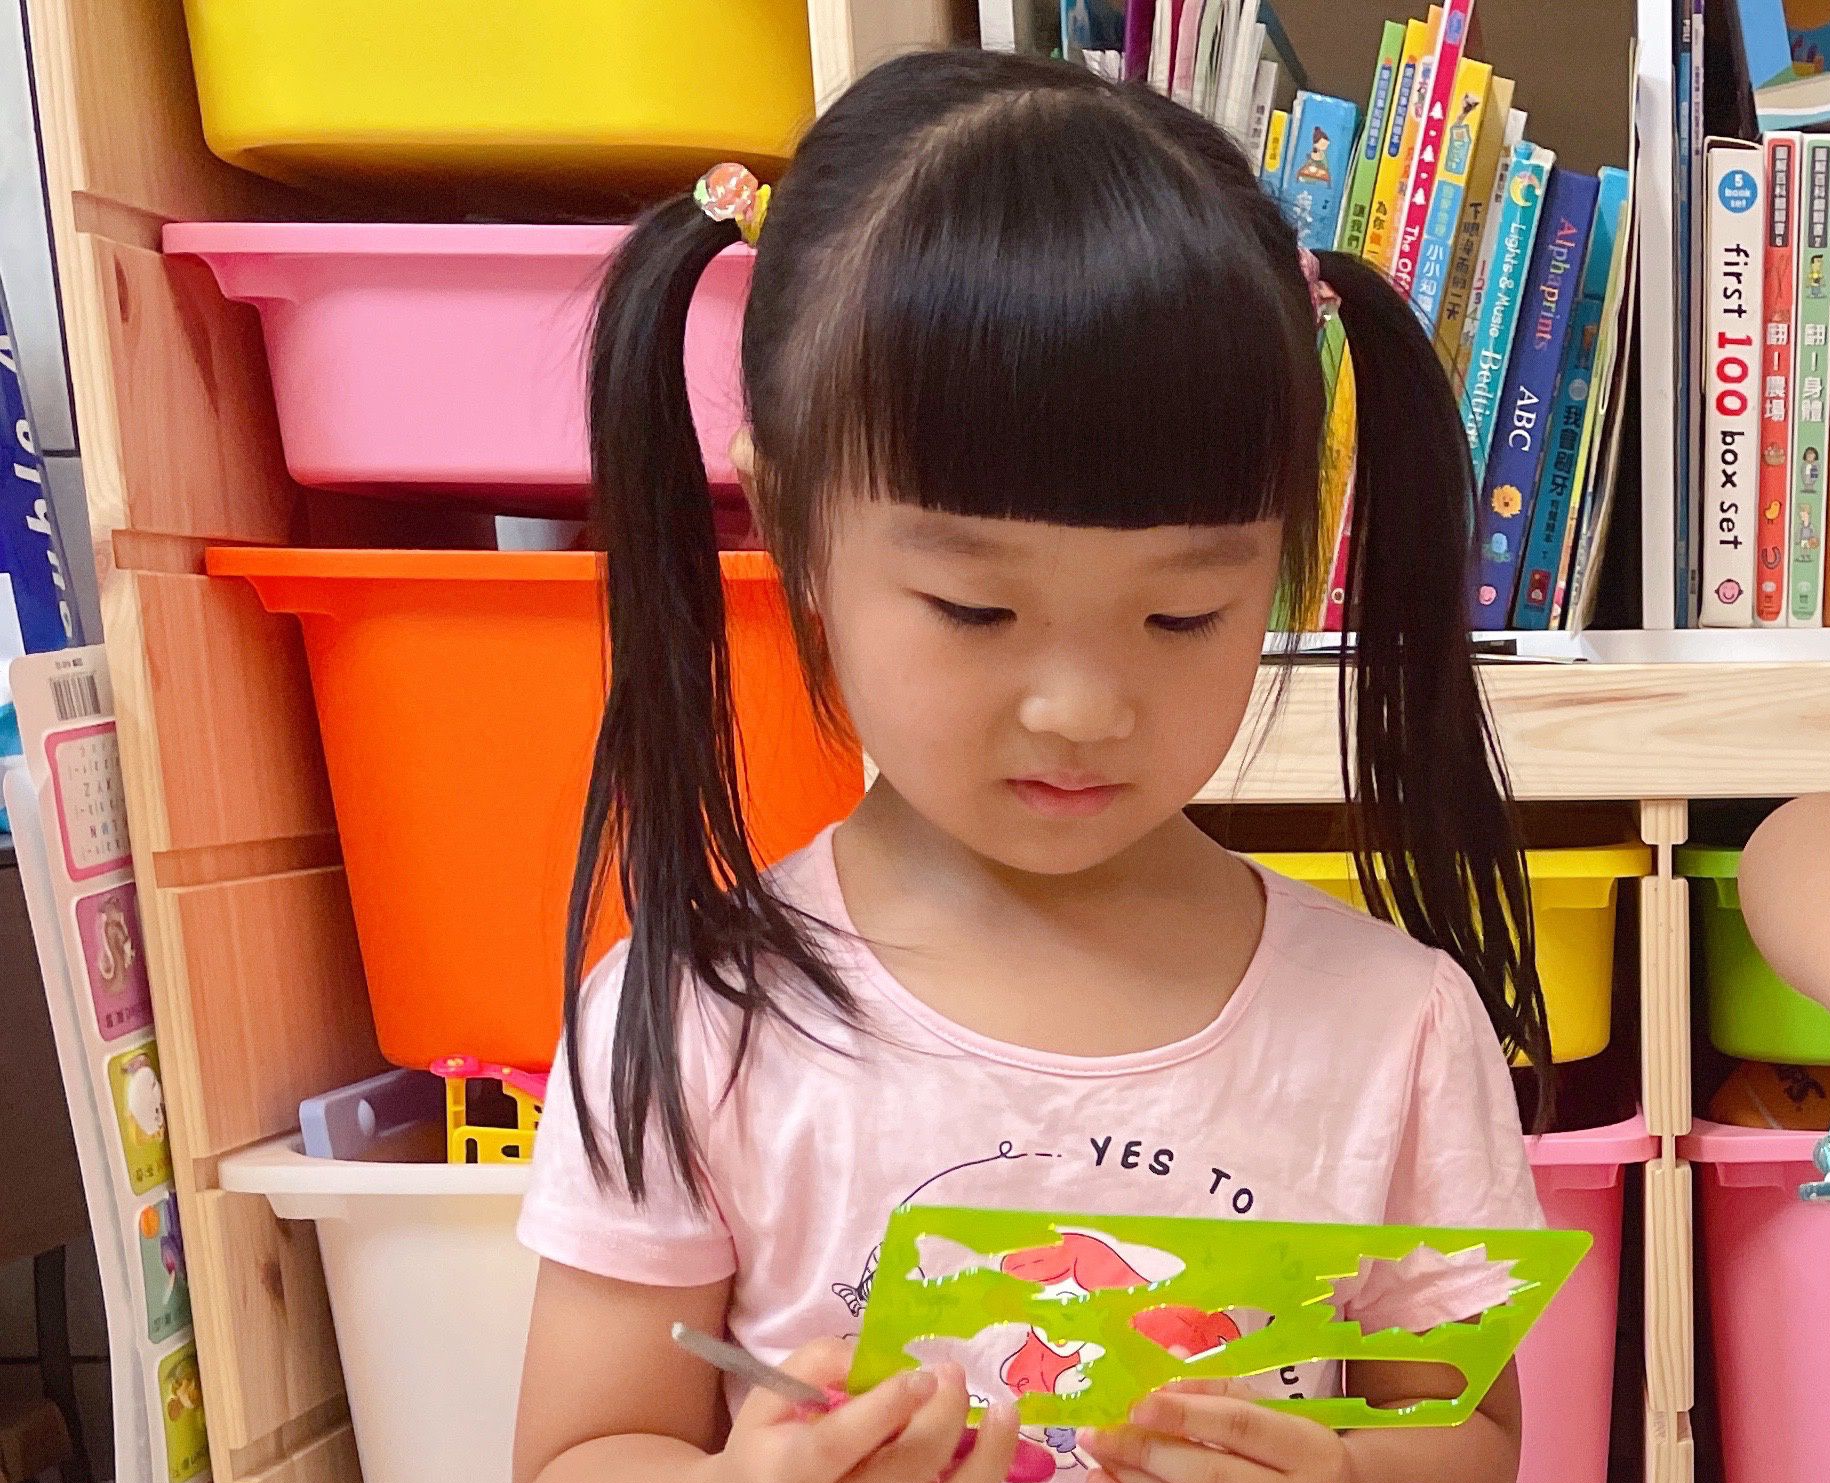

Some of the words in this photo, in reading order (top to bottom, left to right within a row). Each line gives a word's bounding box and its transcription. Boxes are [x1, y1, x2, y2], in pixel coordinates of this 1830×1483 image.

[1533, 217, 1578, 351] Alphaprints
[1722, 243, 1750, 319] first
[1715, 331, 1753, 417] 100
[1508, 385, 1540, 453] ABC
[1719, 430, 1745, 489] box
[1719, 501, 1743, 551] set
[1090, 1135, 1174, 1176] YES
[1208, 1166, 1254, 1214] TO
